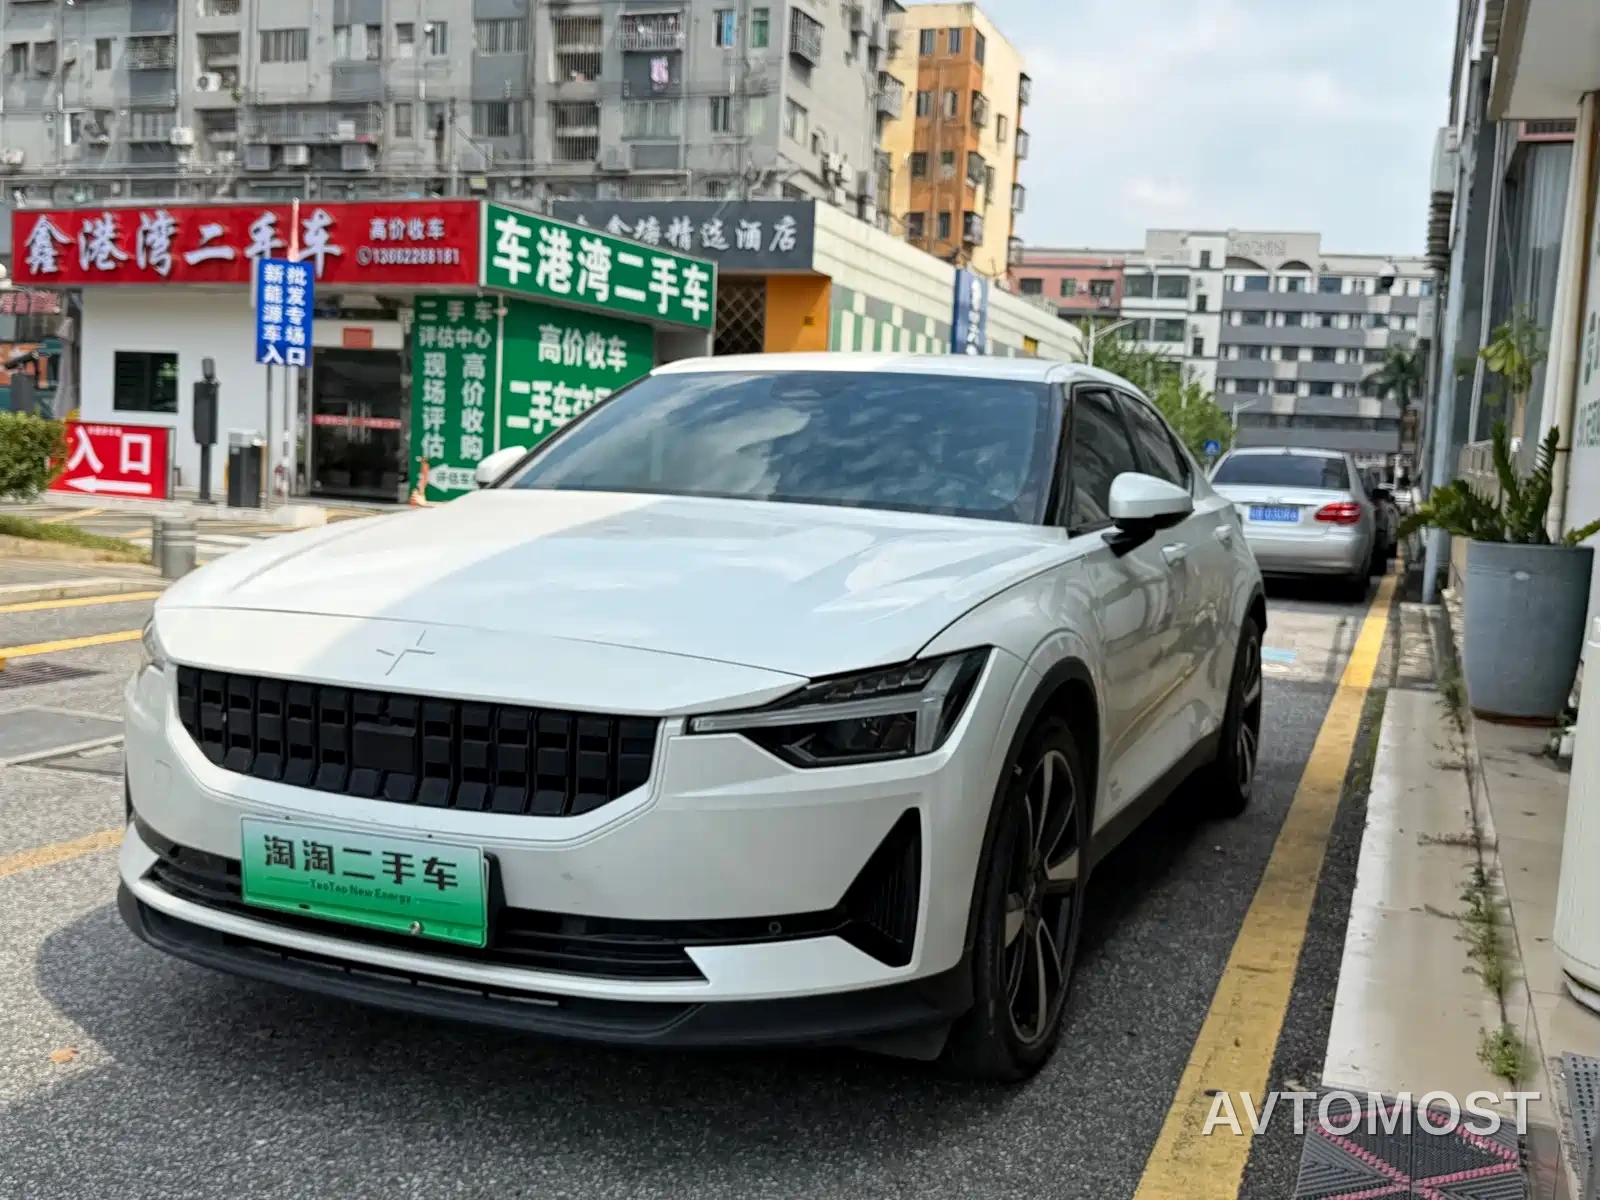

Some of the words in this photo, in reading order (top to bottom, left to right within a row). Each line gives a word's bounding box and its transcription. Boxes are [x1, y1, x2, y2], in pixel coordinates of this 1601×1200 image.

[25, 208, 342, 278] 鑫港湾二手车
[369, 217, 445, 241] 高价收车
[492, 215, 710, 321] 车港湾二手车
[418, 300, 493, 322] 二手车
[418, 325, 492, 349] 评估中心
[537, 324, 628, 373] 高价收车
[421, 352, 447, 460] 现场评估
[460, 352, 487, 462] 高价收购
[67, 425, 152, 476] 入口
[264, 834, 459, 891] 淘淘二手车
[309, 878, 349, 895] TaoTao
[350, 887, 373, 898] New
[375, 888, 412, 904] Energy
